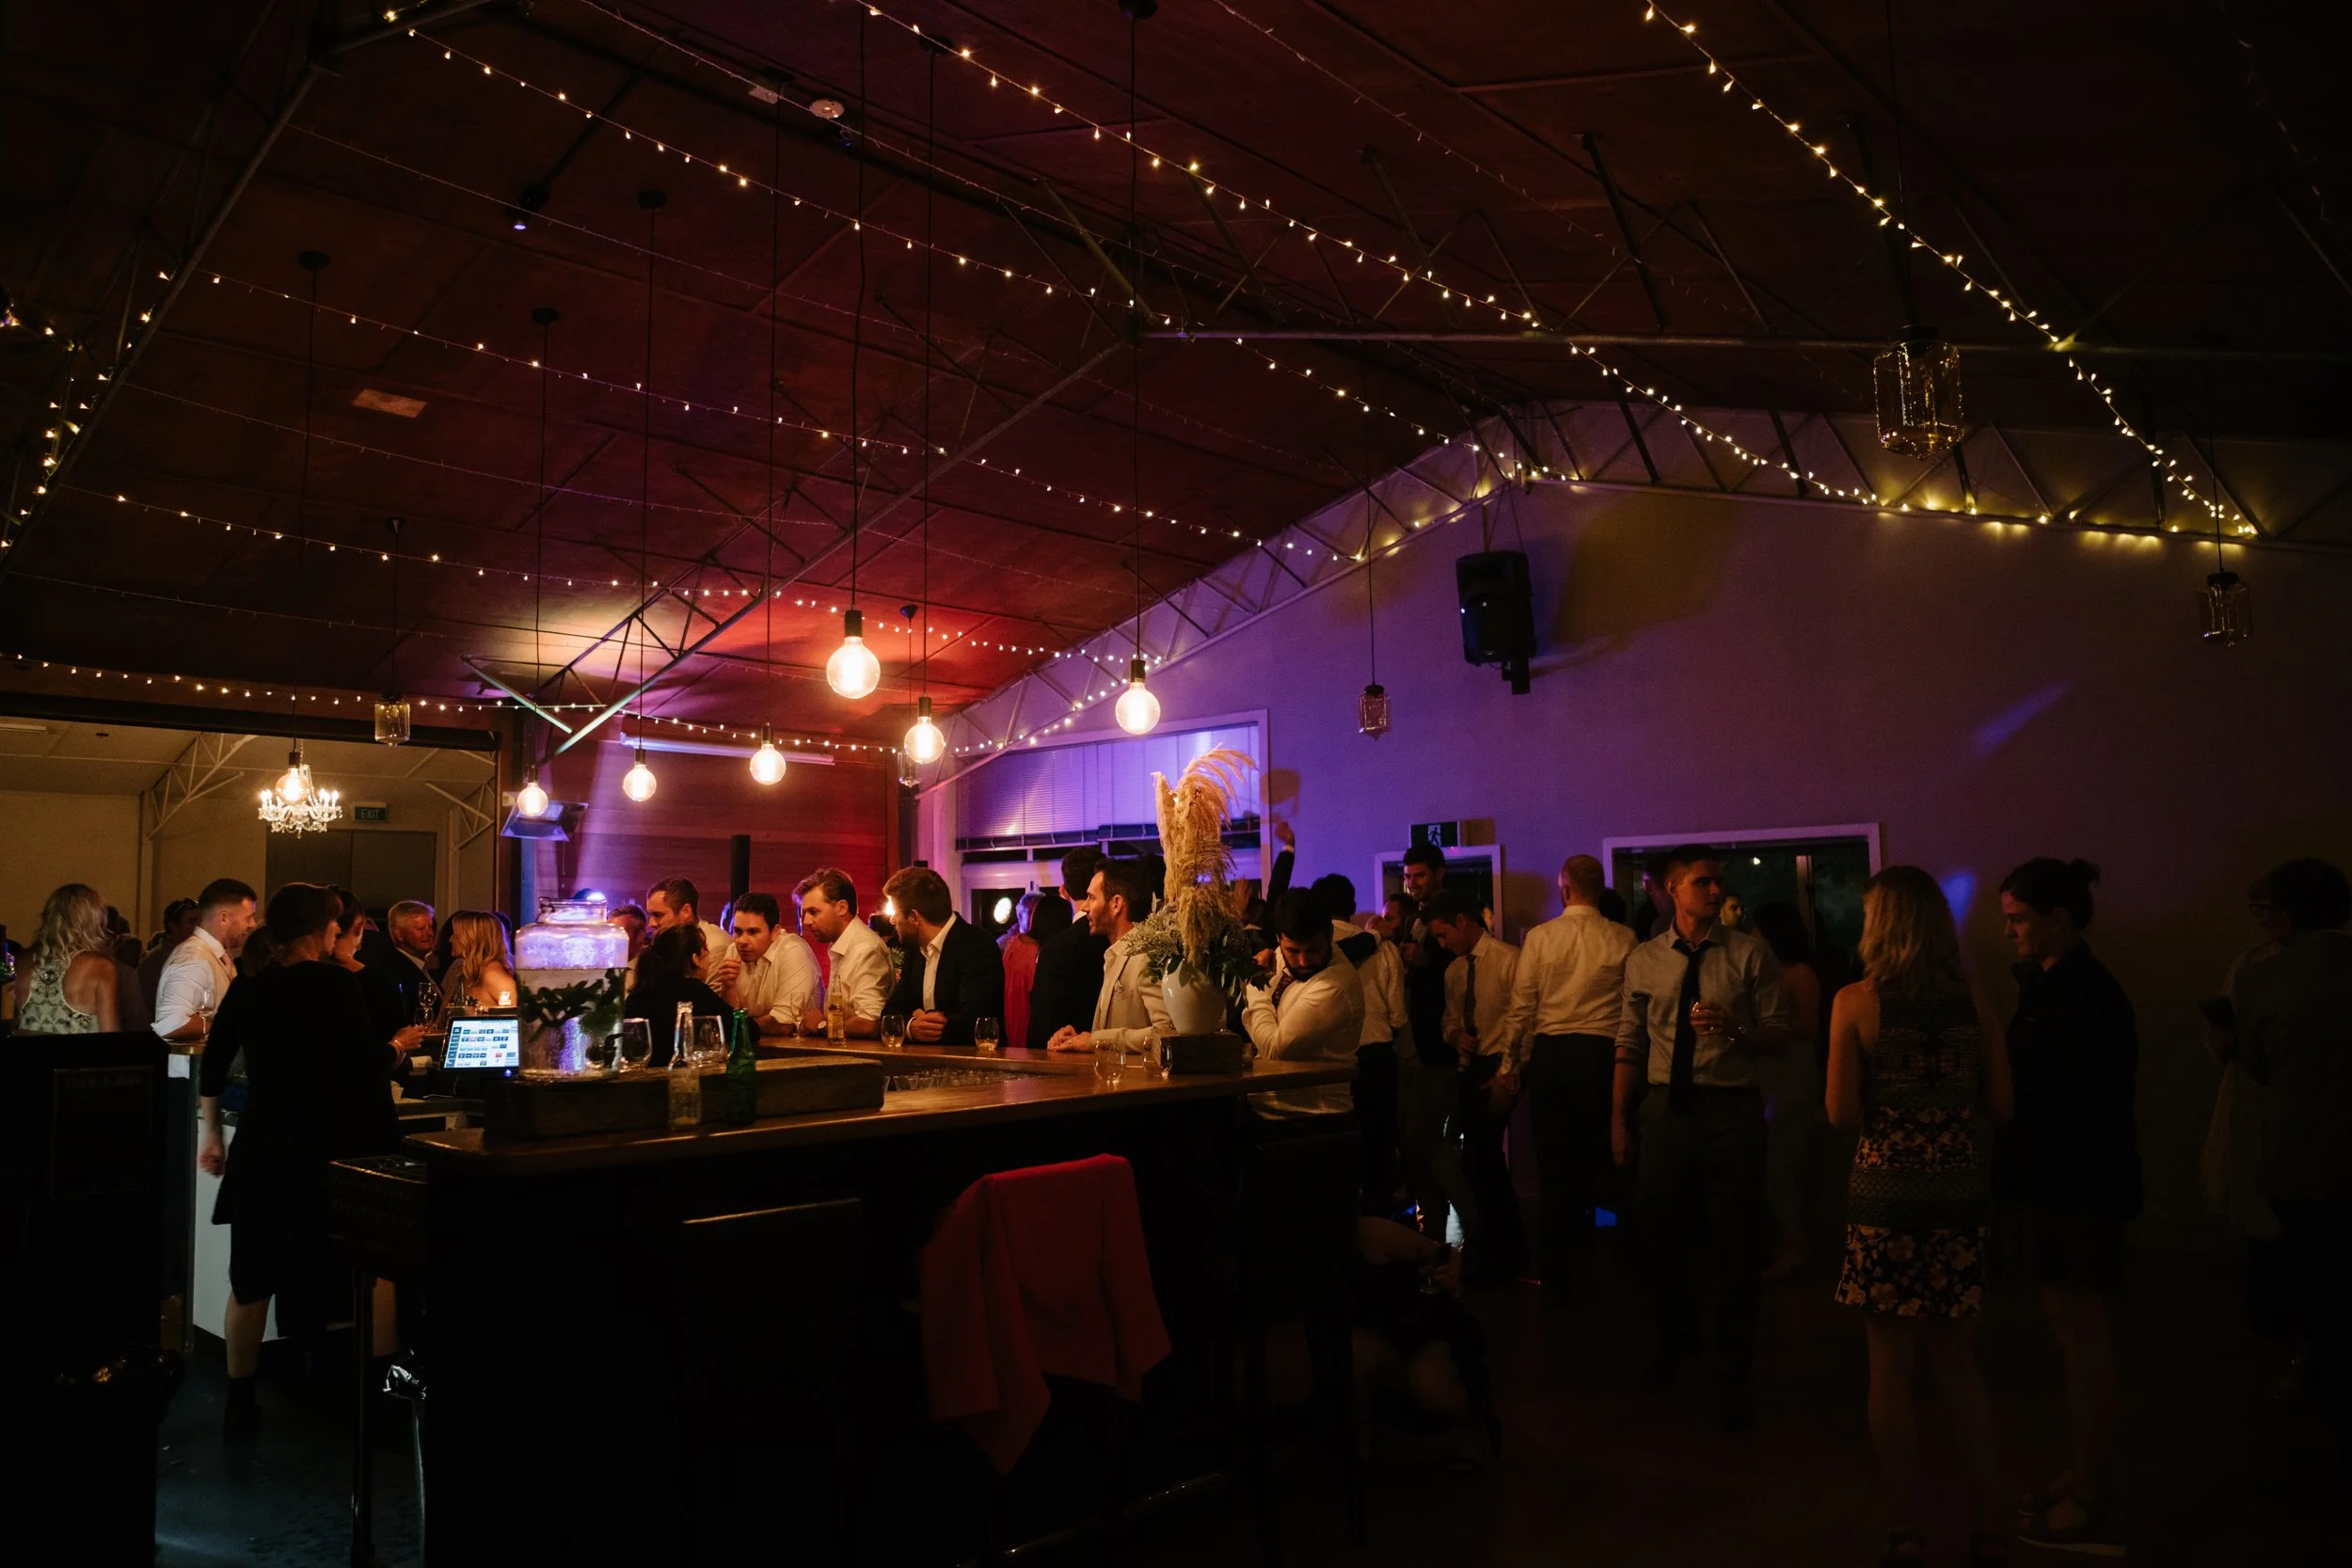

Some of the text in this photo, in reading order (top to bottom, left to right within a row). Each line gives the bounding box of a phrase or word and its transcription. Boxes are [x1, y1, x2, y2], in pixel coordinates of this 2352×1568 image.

[361, 809, 380, 819] EXIT
[63, 1072, 145, 1090] THE LAW
